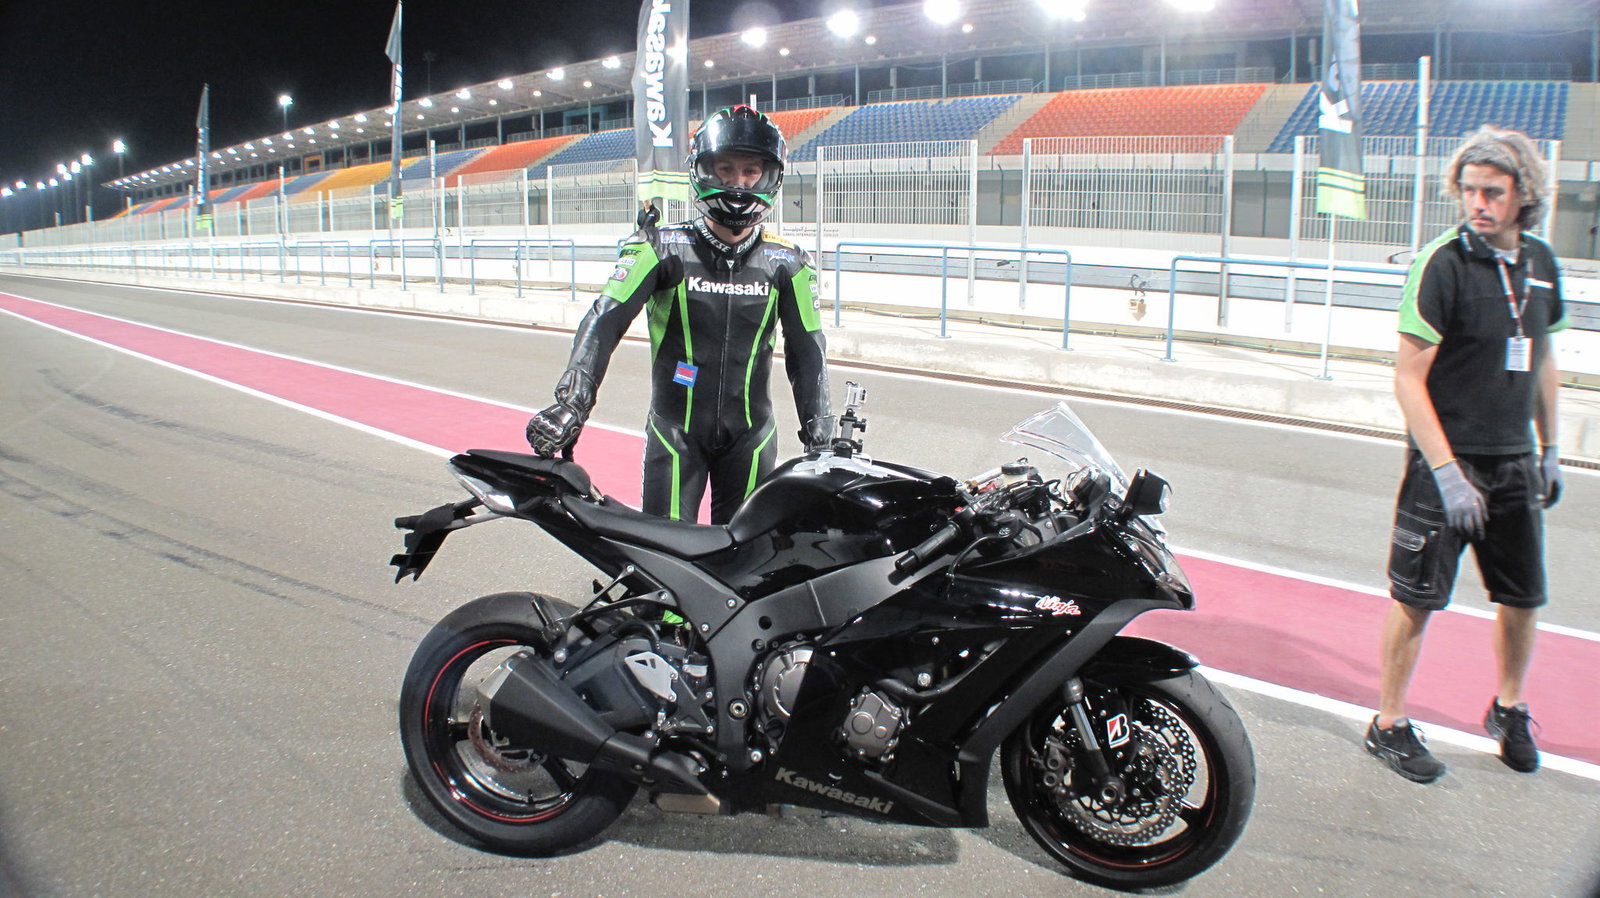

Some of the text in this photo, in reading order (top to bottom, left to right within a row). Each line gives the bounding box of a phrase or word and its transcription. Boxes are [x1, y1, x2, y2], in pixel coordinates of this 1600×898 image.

[688, 277, 769, 296] Kawasaki
[1035, 595, 1081, 615] Ninja
[775, 767, 894, 814] Kawasaki
